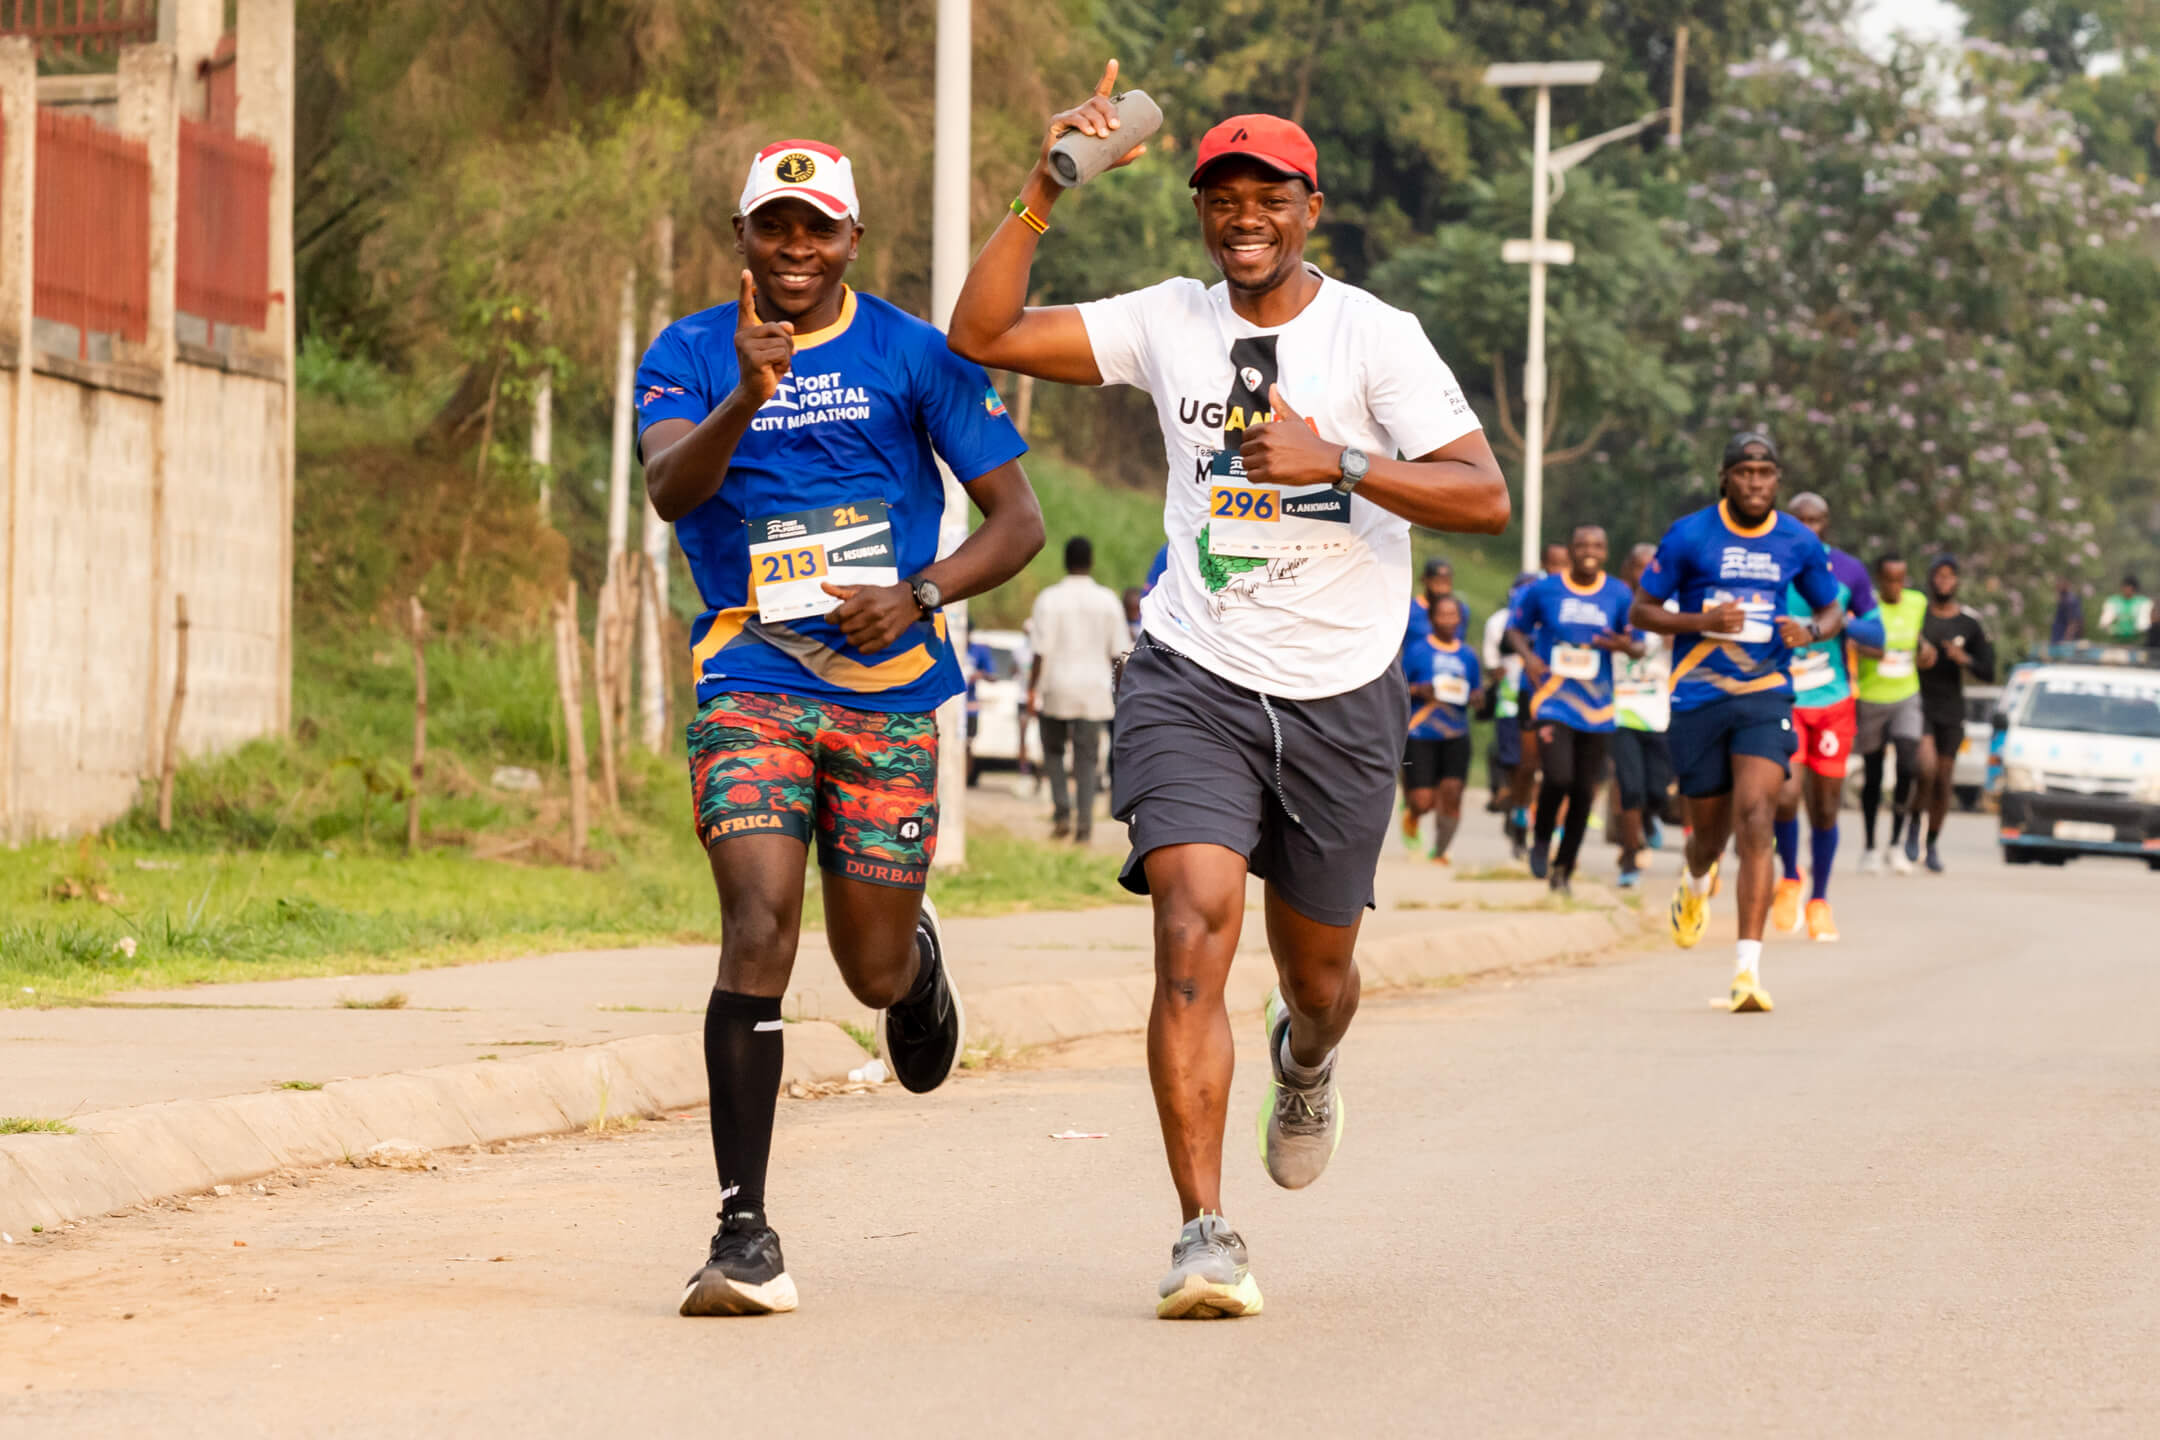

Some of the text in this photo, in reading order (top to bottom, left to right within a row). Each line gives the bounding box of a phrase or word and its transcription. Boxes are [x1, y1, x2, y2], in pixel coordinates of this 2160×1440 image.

[795, 372, 841, 392] FORT
[799, 387, 869, 410] PORTAL
[751, 406, 870, 431] CITY MARATHON
[1215, 490, 1273, 519] 296
[1286, 503, 1296, 512] P.
[762, 550, 817, 583] 213
[832, 552, 843, 563] E.
[711, 814, 784, 839] AFRICA
[846, 860, 924, 884] DURBAN
